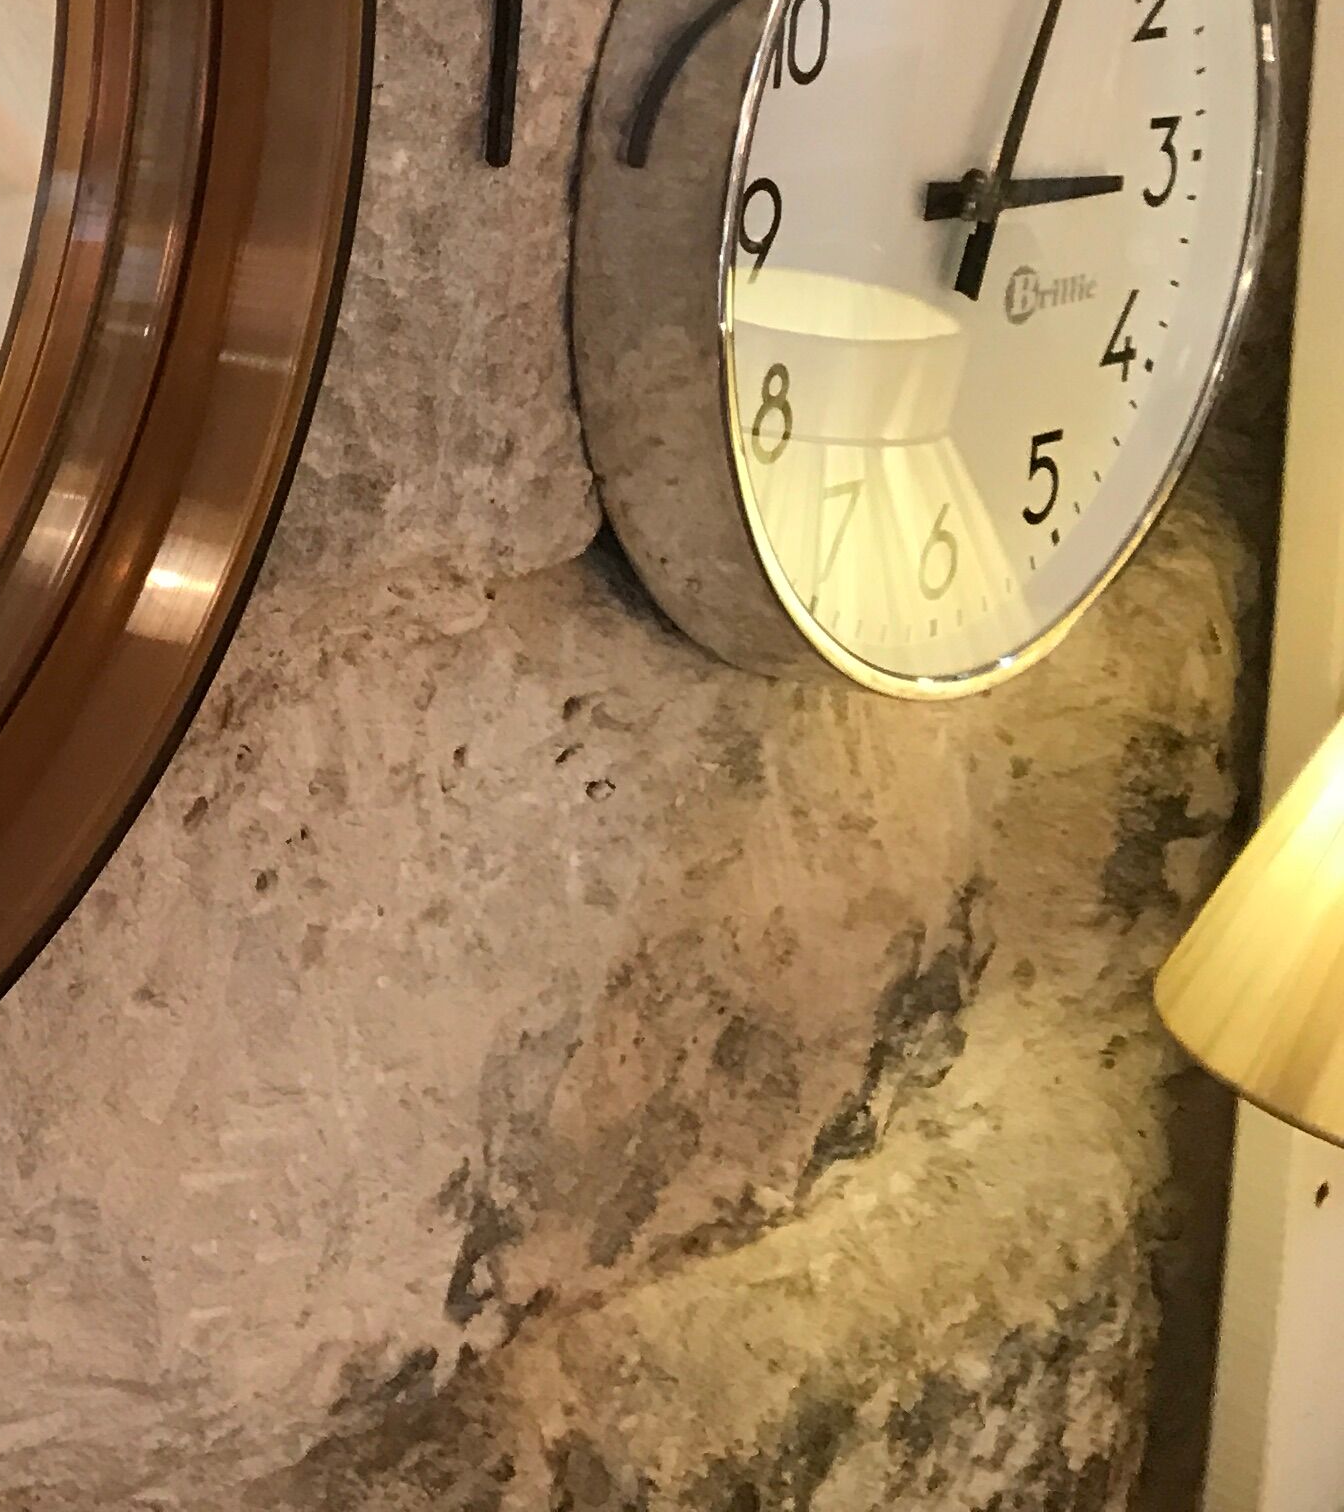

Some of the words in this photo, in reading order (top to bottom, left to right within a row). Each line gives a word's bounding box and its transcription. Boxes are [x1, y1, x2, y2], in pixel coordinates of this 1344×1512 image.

[1142, 115, 1183, 207] 3
[738, 177, 783, 285] 9
[1004, 265, 1097, 325] Brillie
[1098, 289, 1140, 383] 4
[751, 362, 794, 465] 8
[1022, 428, 1064, 525] 5
[819, 478, 866, 584] 7
[917, 502, 958, 601] 6
